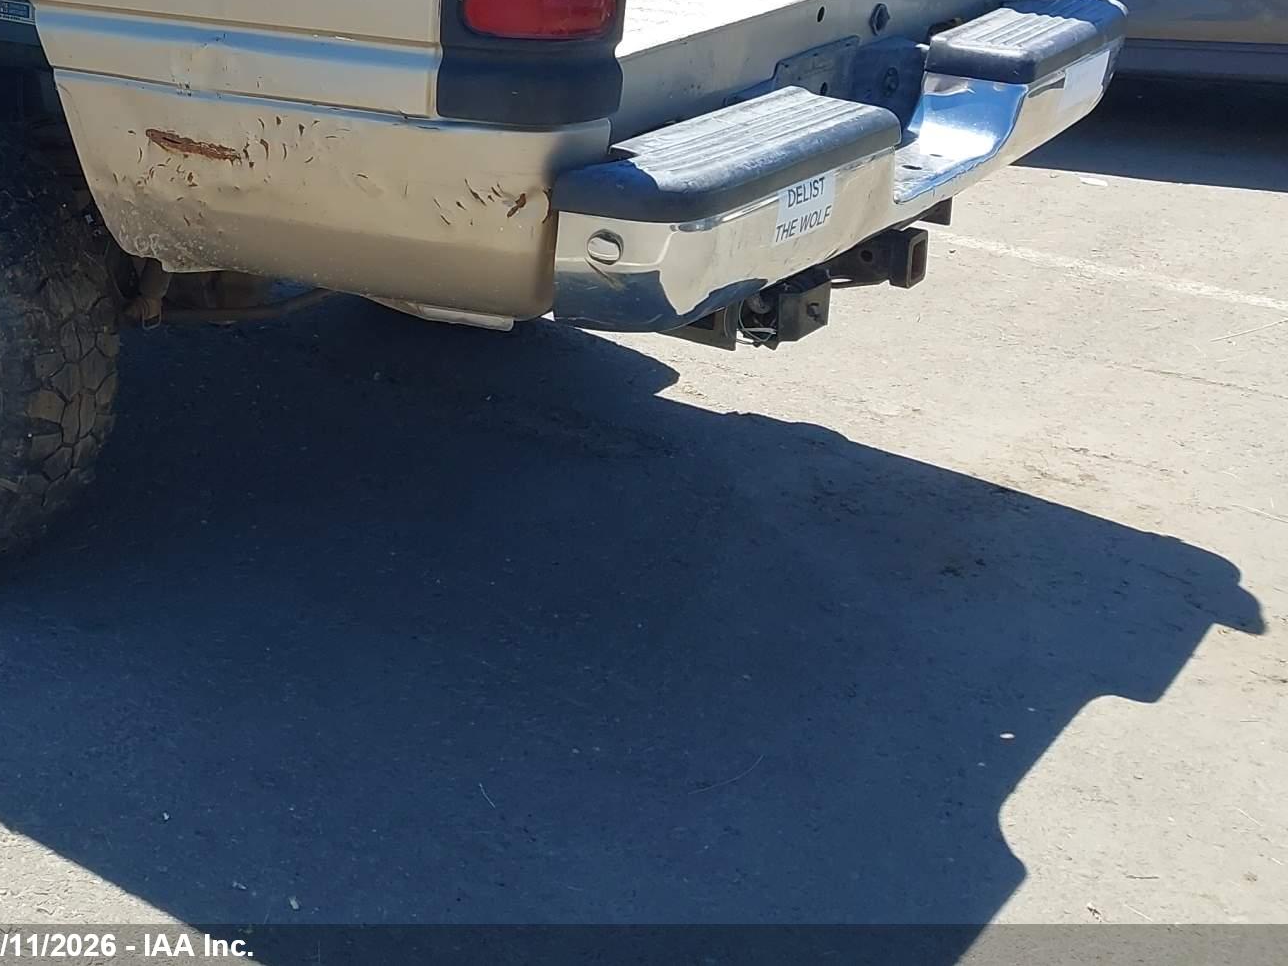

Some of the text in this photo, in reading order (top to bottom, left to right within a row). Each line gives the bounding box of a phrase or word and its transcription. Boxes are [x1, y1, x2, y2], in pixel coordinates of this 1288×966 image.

[787, 176, 825, 208] DELIST
[775, 204, 832, 243] THE WOLF
